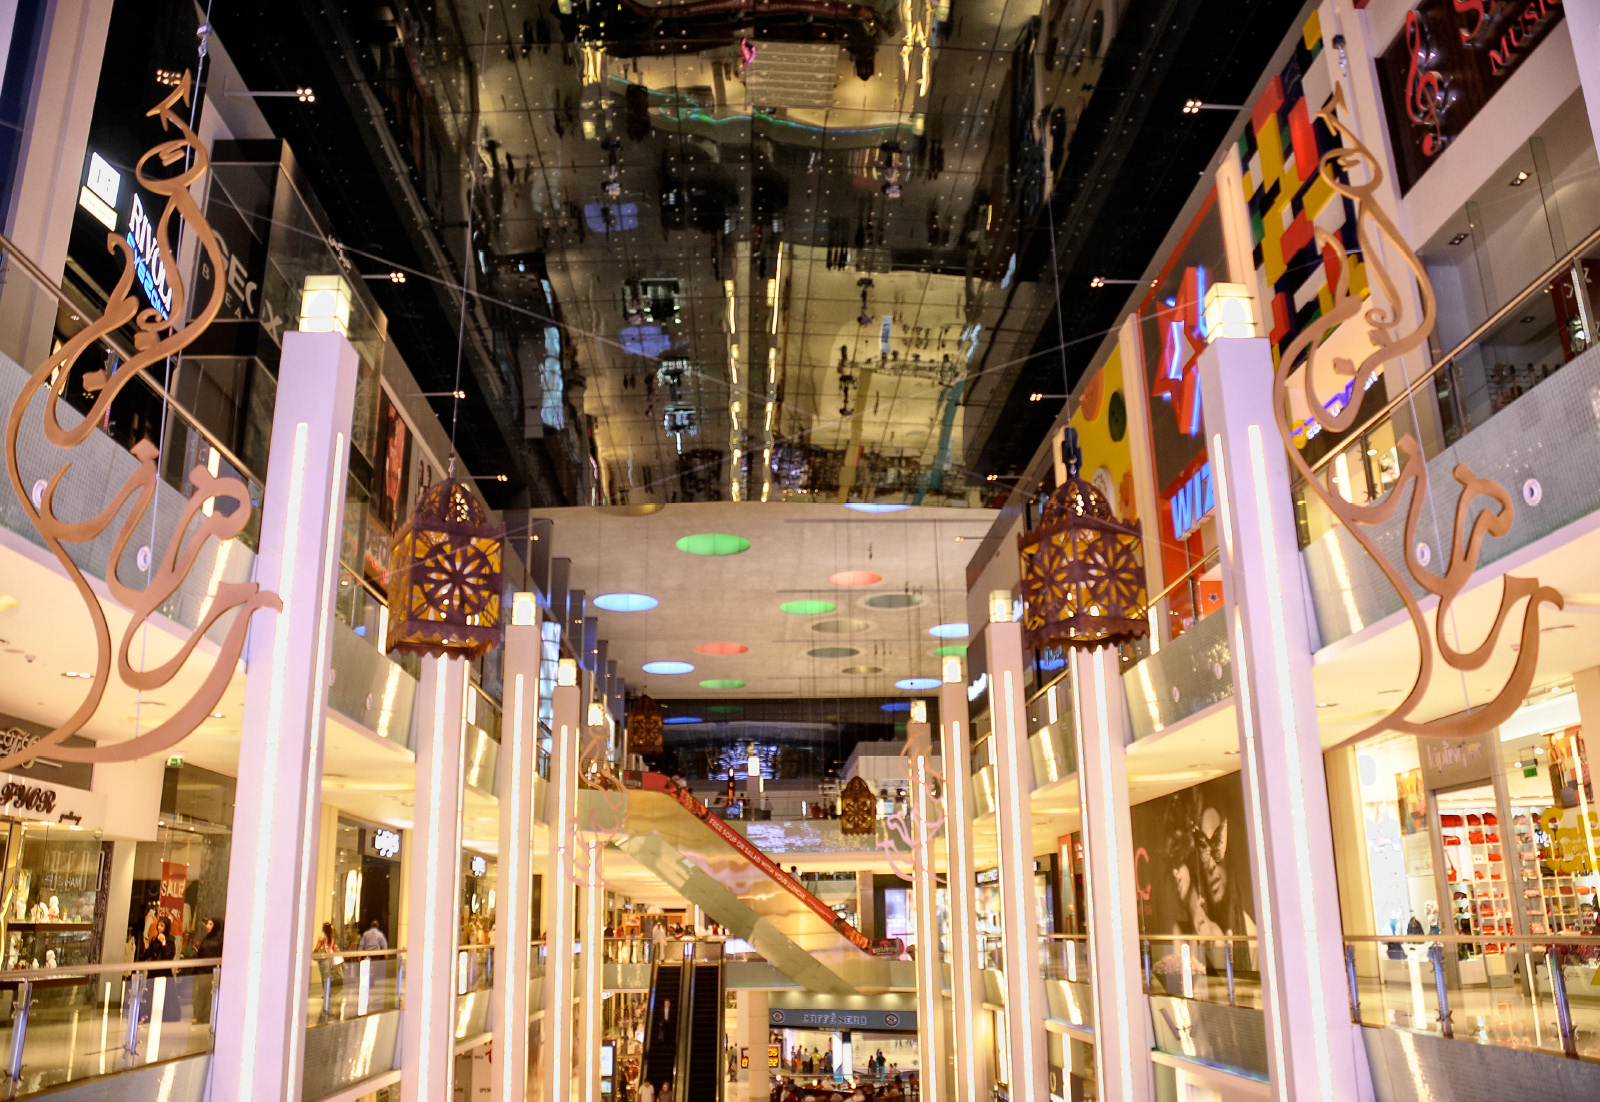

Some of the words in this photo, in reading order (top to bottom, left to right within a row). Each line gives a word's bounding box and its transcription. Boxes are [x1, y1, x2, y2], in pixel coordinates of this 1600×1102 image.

[1489, 0, 1558, 75] MUSI
[708, 818, 723, 832] FREE
[721, 829, 737, 843] SOUP
[736, 841, 745, 850] OR
[743, 847, 761, 863] SALAD
[760, 860, 775, 874] WITH
[774, 871, 788, 885] YOUR
[161, 880, 184, 899] SALE
